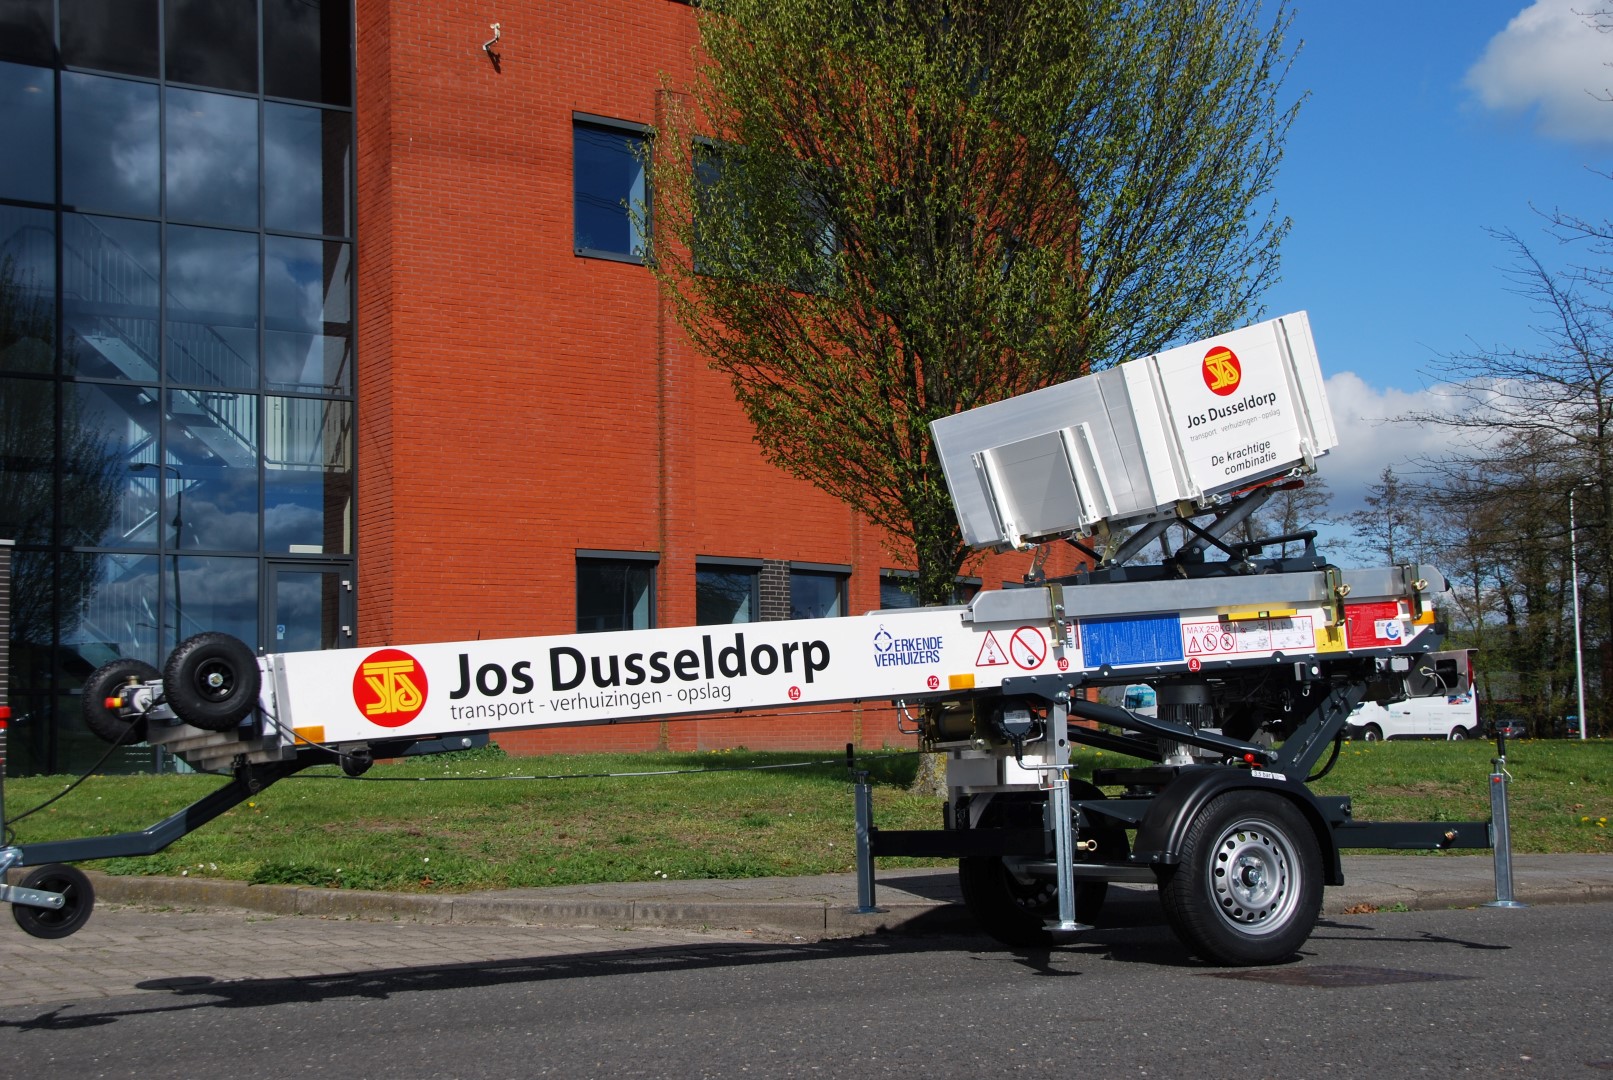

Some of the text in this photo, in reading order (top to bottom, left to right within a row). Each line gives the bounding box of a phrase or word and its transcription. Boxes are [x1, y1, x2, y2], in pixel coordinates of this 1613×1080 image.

[1187, 392, 1276, 429] Jos Dusseldorp
[1190, 429, 1218, 442] transport
[1220, 416, 1258, 432] verhuizingen
[1261, 408, 1281, 420] opslag
[1211, 441, 1271, 467] De krachtige
[1225, 452, 1277, 475] combinatie
[894, 636, 944, 652] ERKENDE
[450, 632, 830, 700] Jos Dusseldorp
[874, 650, 940, 667] VERHUIZERS
[1058, 659, 1068, 668] 10
[789, 688, 800, 697] 14
[928, 677, 938, 686] 12
[450, 699, 535, 720] transport
[550, 690, 661, 712] verhuizingen
[677, 682, 731, 704] opslag
